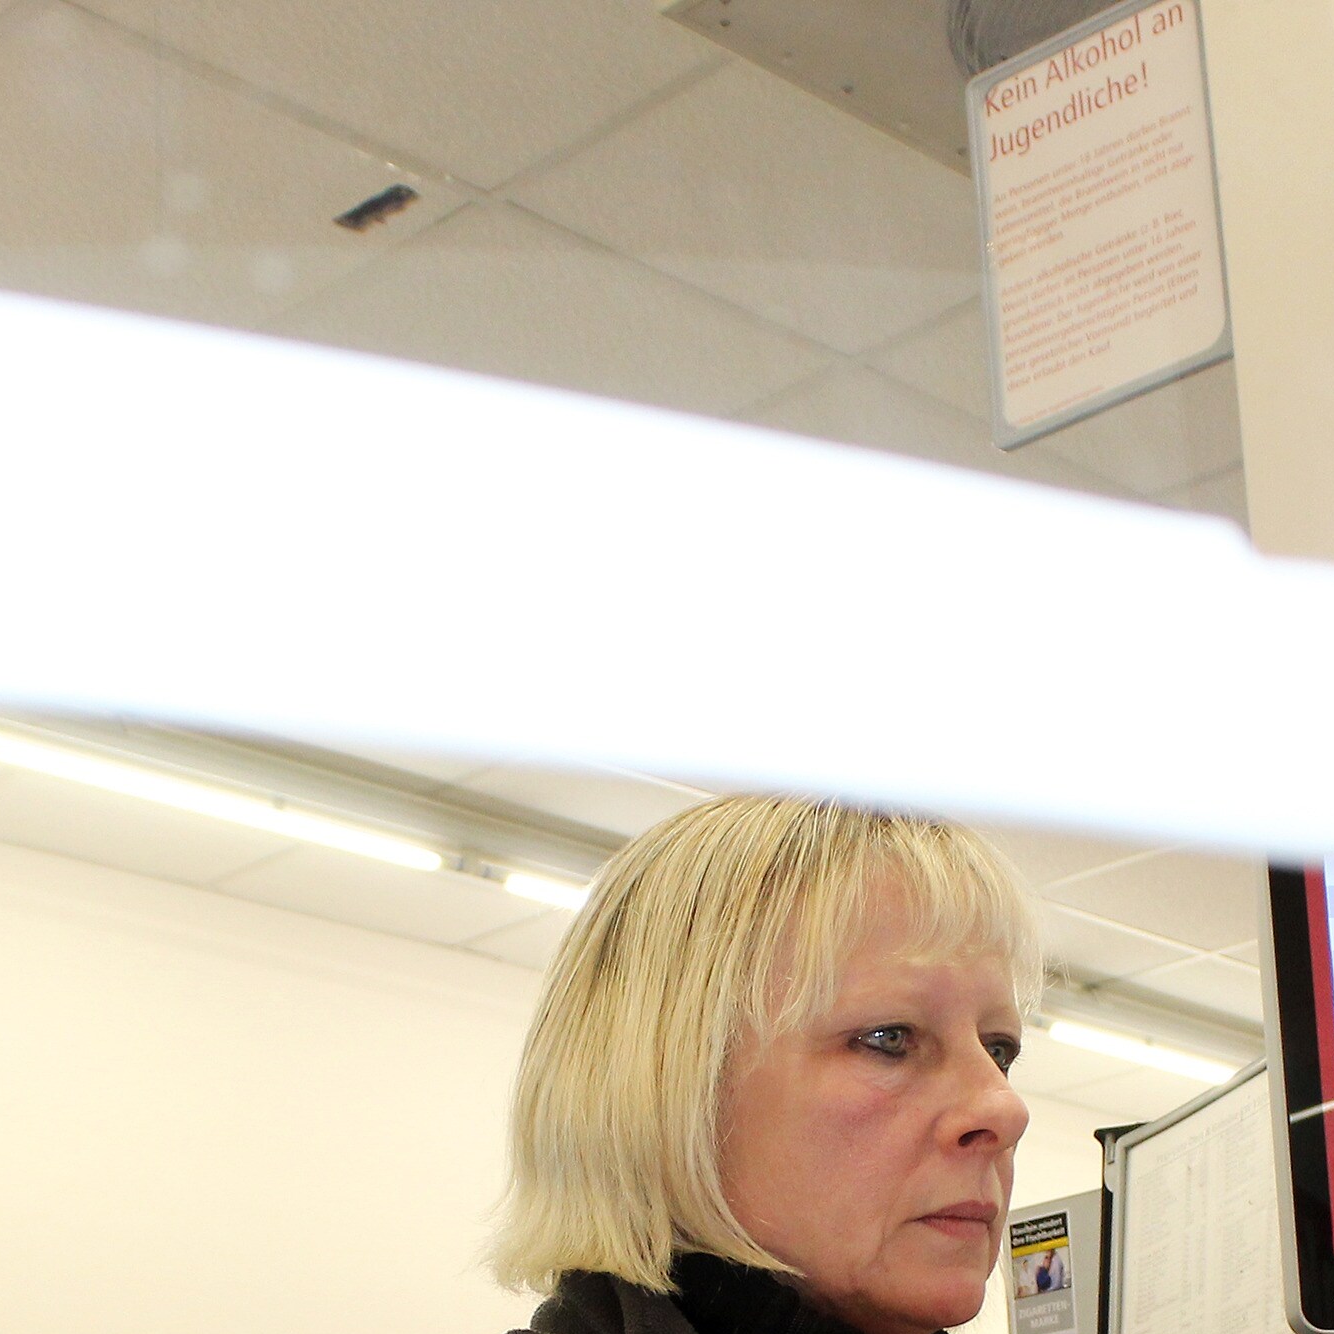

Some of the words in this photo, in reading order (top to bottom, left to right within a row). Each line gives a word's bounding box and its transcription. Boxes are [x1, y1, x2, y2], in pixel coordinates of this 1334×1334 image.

[984, 75, 1037, 117] Kein
[1046, 14, 1142, 90] Alkohol
[1152, 3, 1183, 36] an
[989, 61, 1148, 162] Jugendliche!
